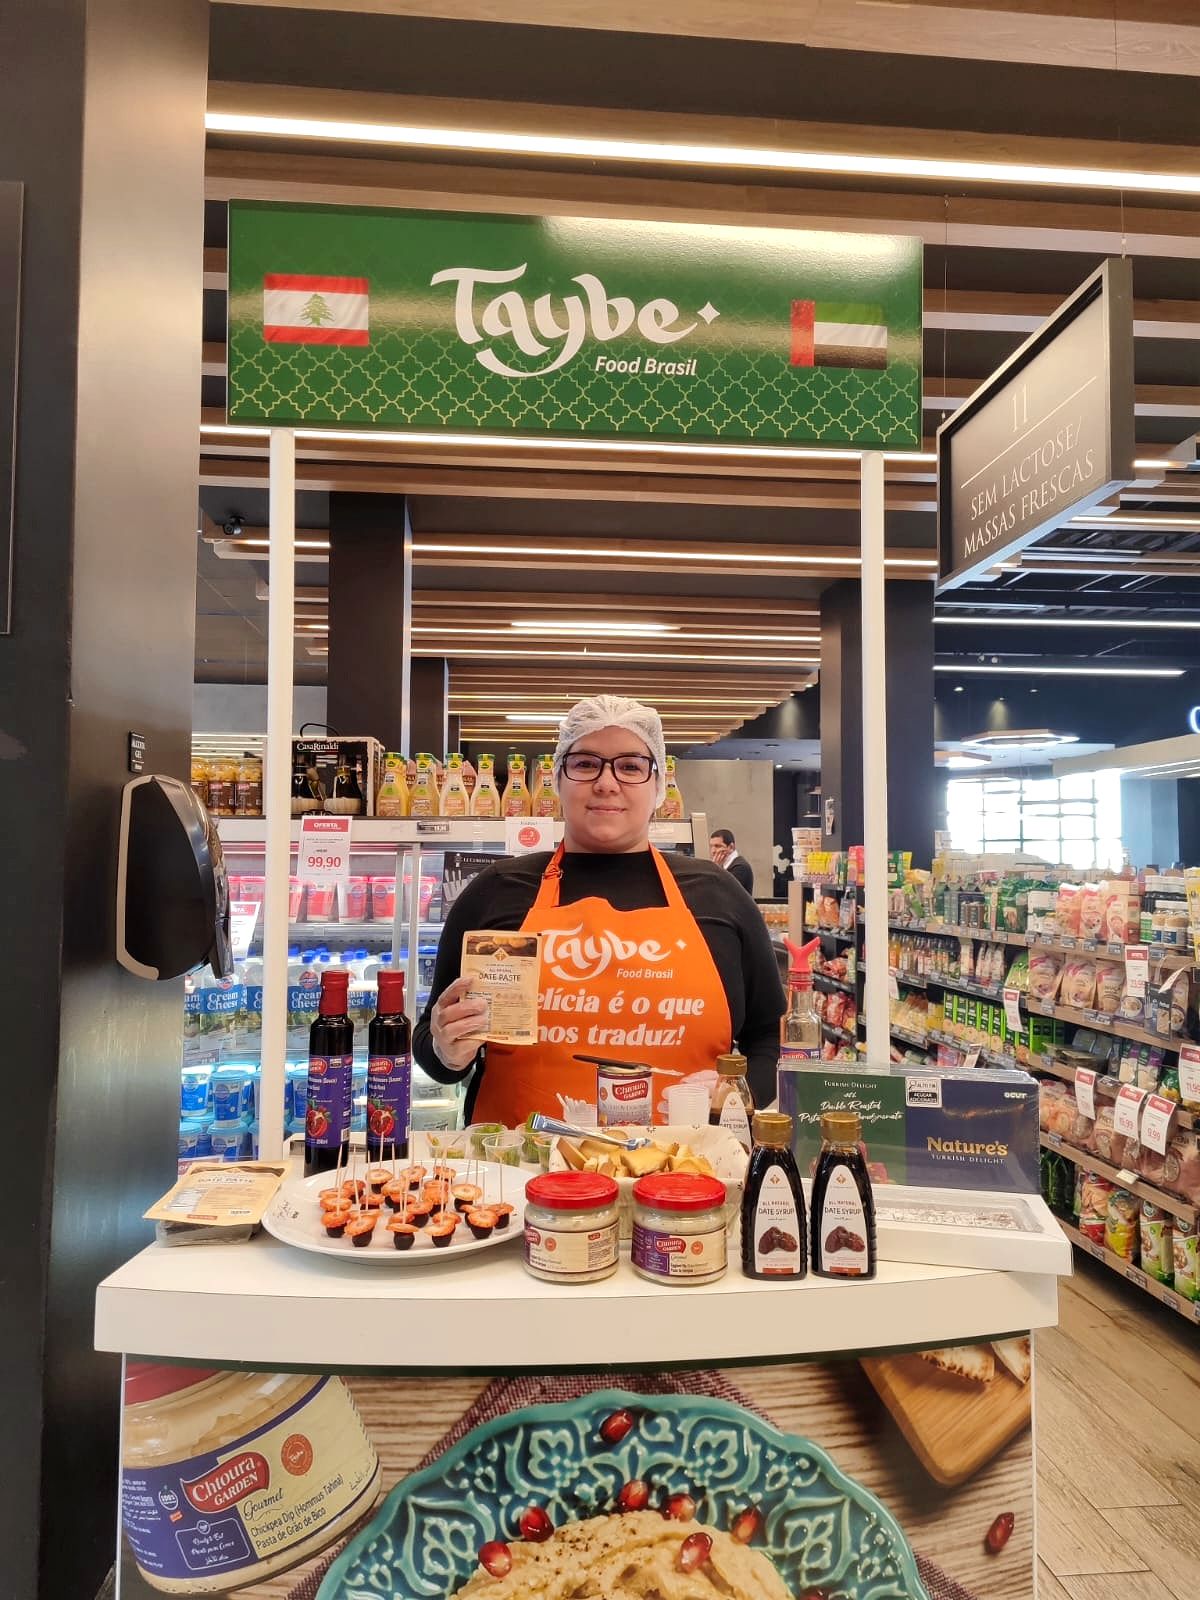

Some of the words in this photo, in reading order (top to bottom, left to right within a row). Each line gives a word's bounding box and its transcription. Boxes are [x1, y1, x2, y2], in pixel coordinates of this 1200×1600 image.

[430, 263, 697, 377] Taybe
[594, 356, 640, 376] Food
[643, 357, 698, 377] Brasil
[971, 486, 998, 521] SEM
[1002, 416, 1083, 498] LACTOSE/
[963, 503, 1016, 558] MASSAS
[1021, 448, 1096, 521] FRESCAS
[307, 856, 342, 869] 99,90
[541, 921, 671, 981] Taybe
[616, 968, 643, 979] Food
[644, 969, 674, 979] Brasil
[208, 991, 239, 1002] Cream
[538, 987, 600, 1013] elícia
[608, 990, 625, 1013] é
[631, 996, 650, 1015] o
[658, 997, 705, 1020] que
[587, 1024, 686, 1046] traduz!
[926, 1136, 1009, 1156] Nature's
[759, 1208, 775, 1216] DATE
[776, 1208, 795, 1216] SYRUP
[825, 1207, 841, 1215] DATE
[192, 1457, 256, 1502] Chtoura
[214, 1471, 258, 1506] GARDEN
[243, 1488, 284, 1521] Gourmet
[250, 1516, 283, 1538] Chickpea
[282, 1510, 295, 1523] Dip
[295, 1491, 325, 1518] (Hommus
[255, 1534, 277, 1550] Pasta
[276, 1530, 288, 1542] de
[286, 1519, 304, 1536] Grão
[303, 1514, 313, 1527] de
[311, 1506, 327, 1522] Bico
